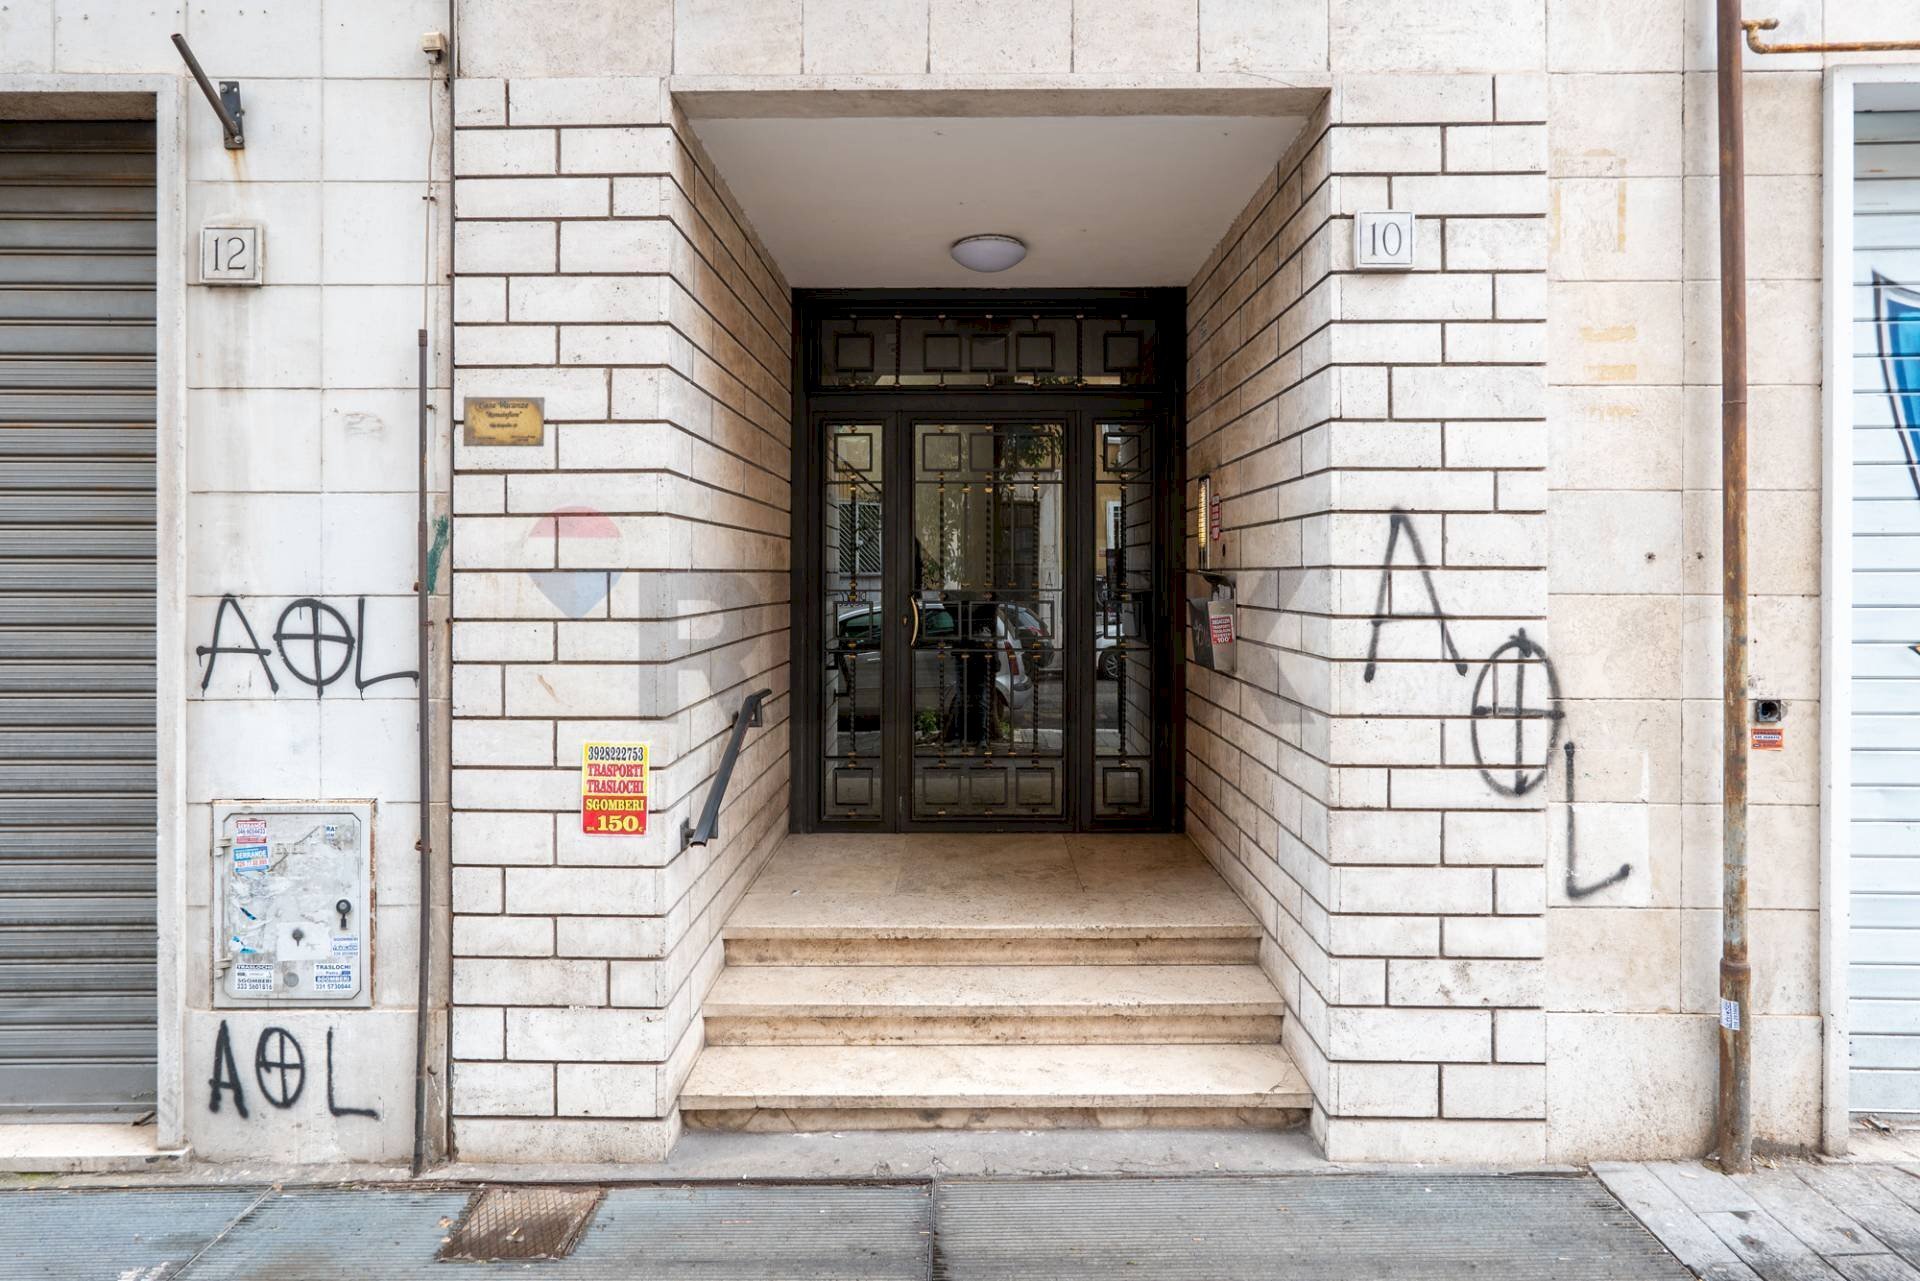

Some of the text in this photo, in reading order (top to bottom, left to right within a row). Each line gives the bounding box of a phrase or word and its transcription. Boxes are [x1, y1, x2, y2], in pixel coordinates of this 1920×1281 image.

[1370, 222, 1402, 256] 10
[213, 236, 247, 271] 12
[588, 746, 644, 761] 3928222753
[587, 763, 644, 778] TRASPORTI
[586, 779, 644, 794] TRASLOCHI
[585, 799, 644, 811] SGOMBERI
